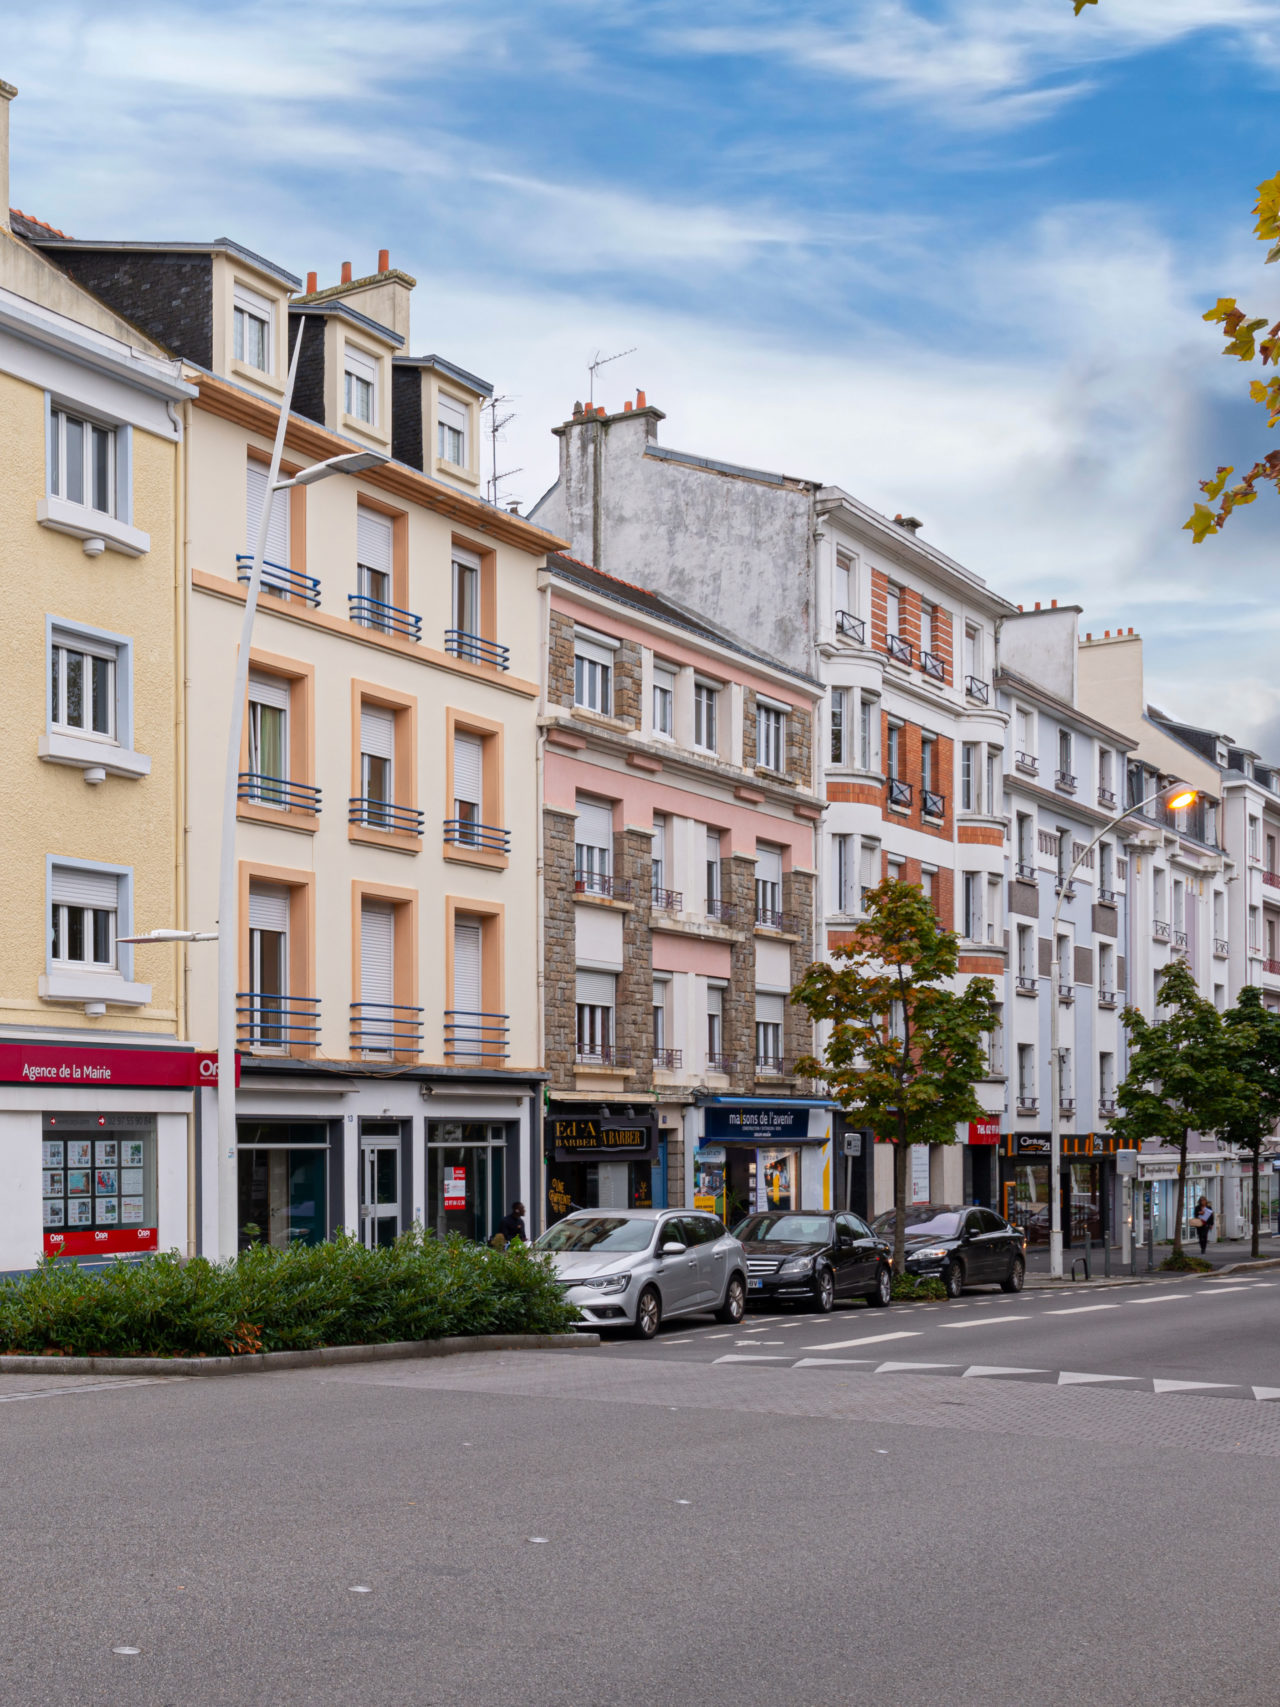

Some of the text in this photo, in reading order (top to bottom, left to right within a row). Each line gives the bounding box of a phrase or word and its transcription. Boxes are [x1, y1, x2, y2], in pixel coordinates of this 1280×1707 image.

[22, 1063, 111, 1080] Agence de la Mairie
[729, 1109, 794, 1125] maisons de l'avenir
[555, 1121, 577, 1137] Ed
[555, 1138, 597, 1147] BARBER
[608, 1130, 640, 1145] BARBER
[50, 1234, 64, 1242] ORPI
[137, 1229, 150, 1237] ORPI
